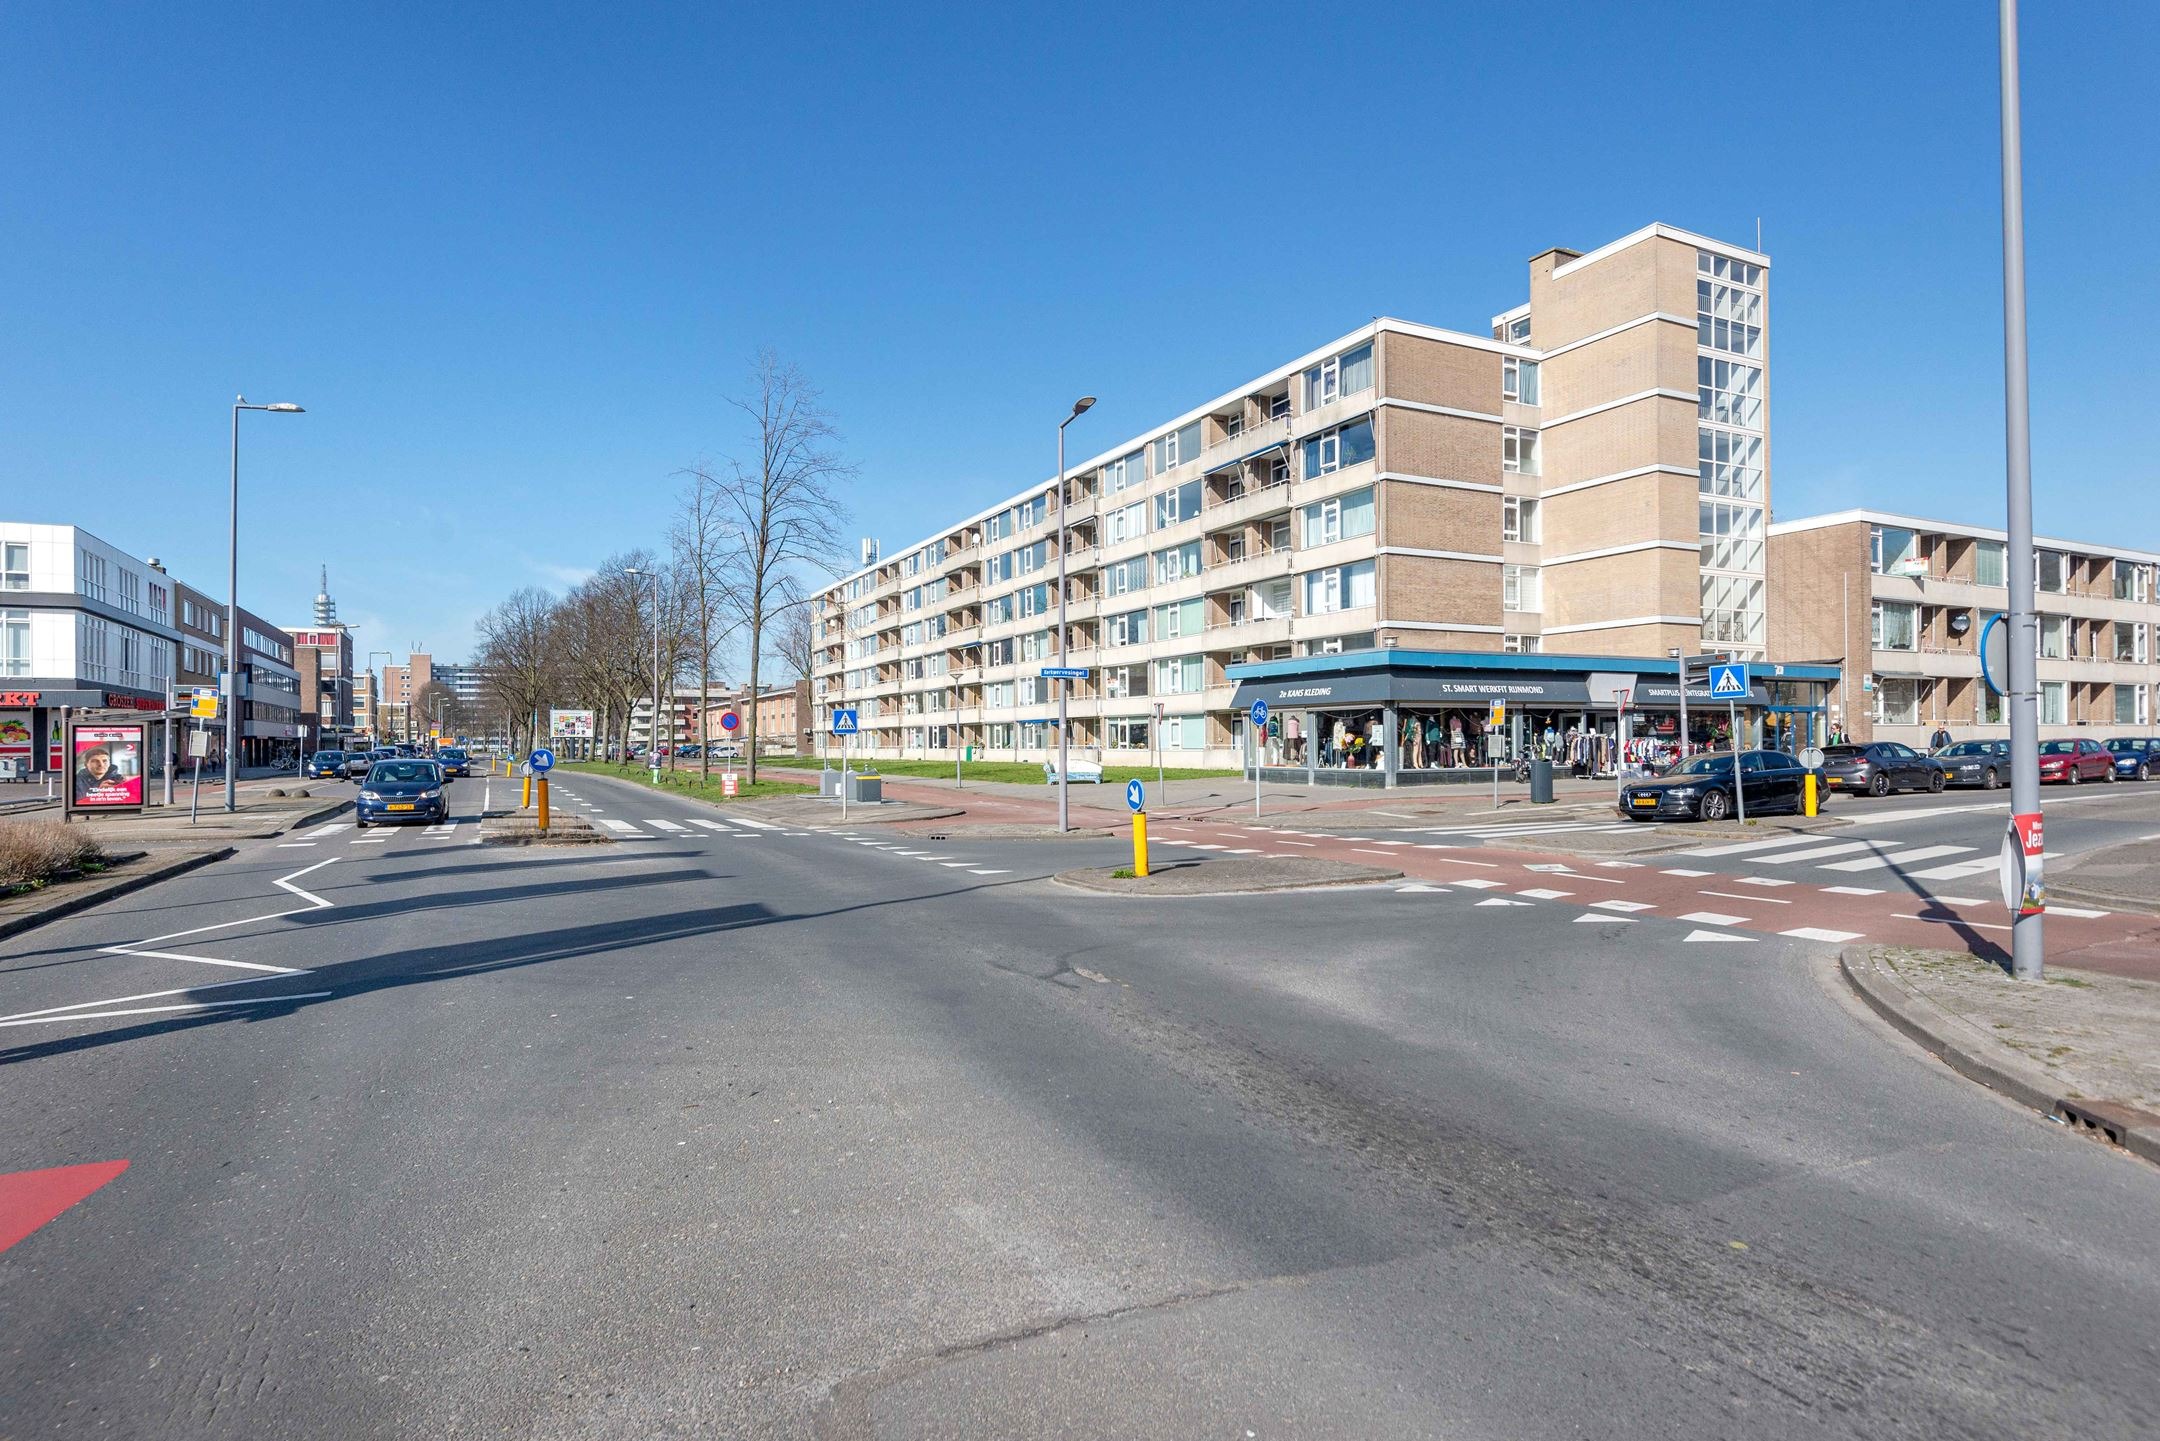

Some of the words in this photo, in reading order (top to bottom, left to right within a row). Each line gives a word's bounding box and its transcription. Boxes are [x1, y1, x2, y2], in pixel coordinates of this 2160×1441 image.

[1279, 690, 1287, 698] 2e
[1287, 689, 1304, 698] KANS
[1304, 687, 1331, 696] KLEDING
[1442, 684, 1453, 693] ST.
[1453, 685, 1478, 693] SMART
[1478, 685, 1508, 694] WERKFIT
